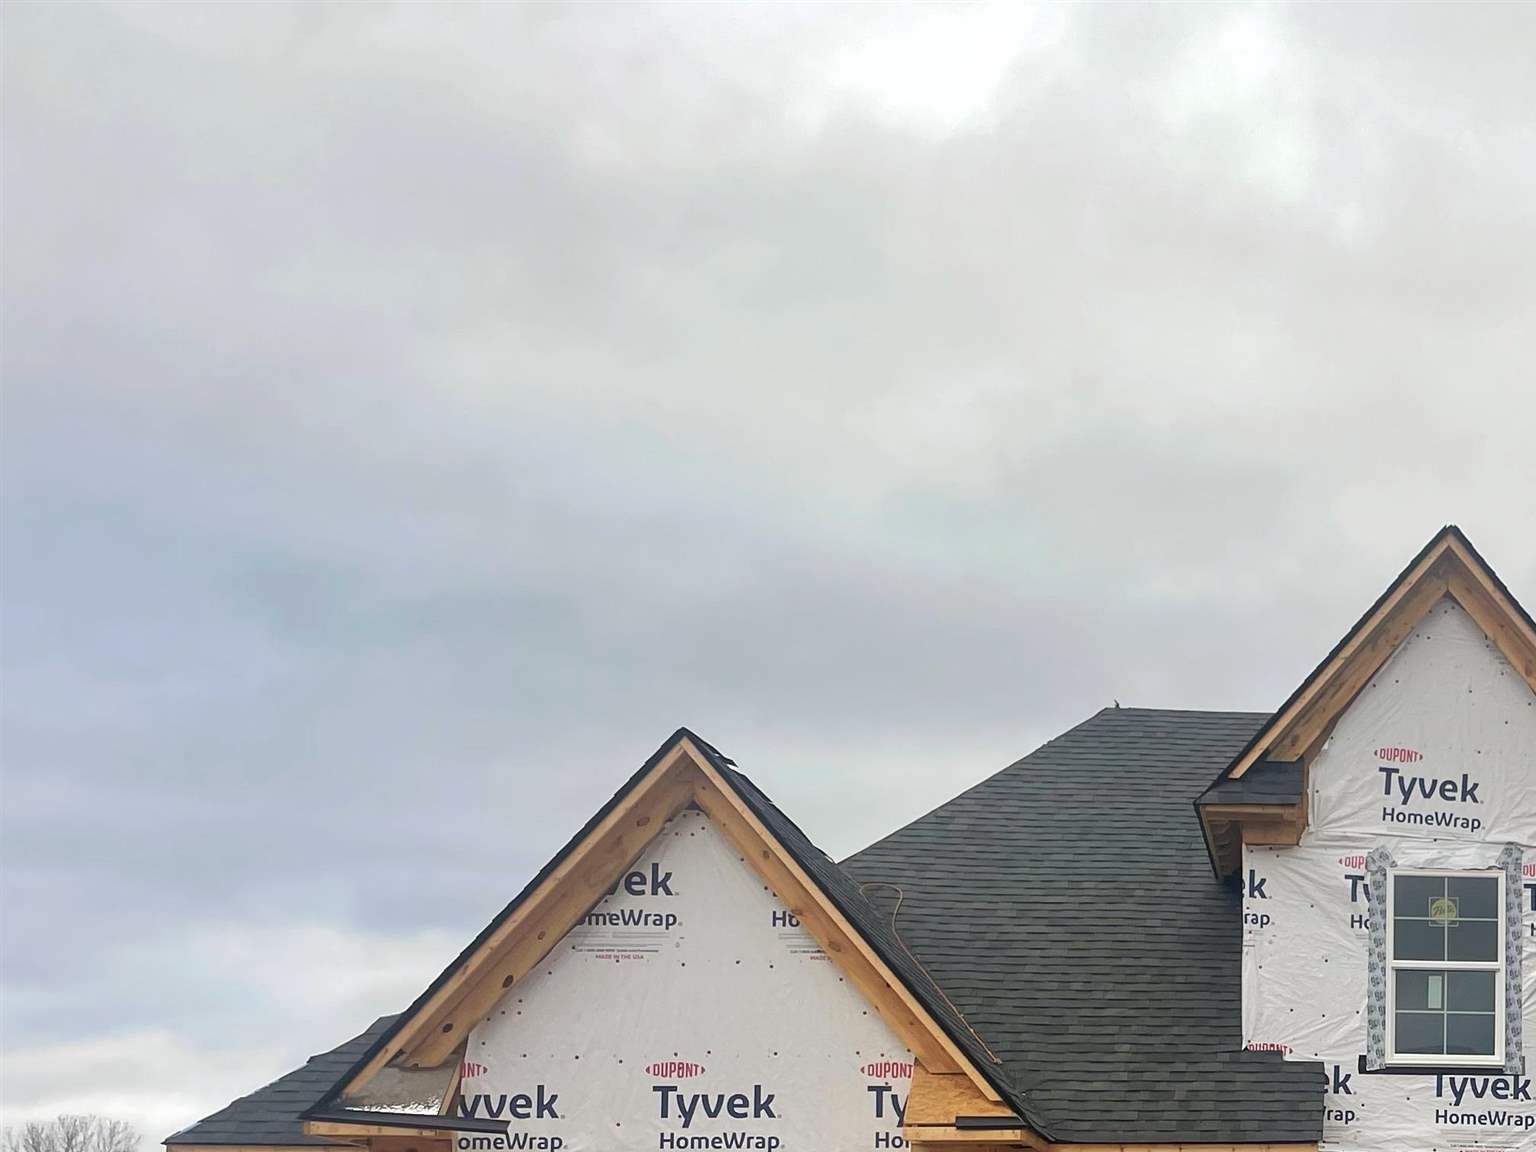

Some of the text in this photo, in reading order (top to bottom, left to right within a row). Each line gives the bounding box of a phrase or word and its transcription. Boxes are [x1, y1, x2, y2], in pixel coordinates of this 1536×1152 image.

[1379, 747, 1419, 764] DUPONT
[1379, 766, 1480, 805] Tyvek
[1382, 806, 1481, 831] HomeWrap
[653, 1062, 699, 1078] DUPONT
[1323, 1065, 1353, 1096] k
[1435, 1073, 1532, 1106] Tyvek
[653, 1084, 776, 1128] Tyvek
[1435, 1108, 1535, 1130] HomeWrap
